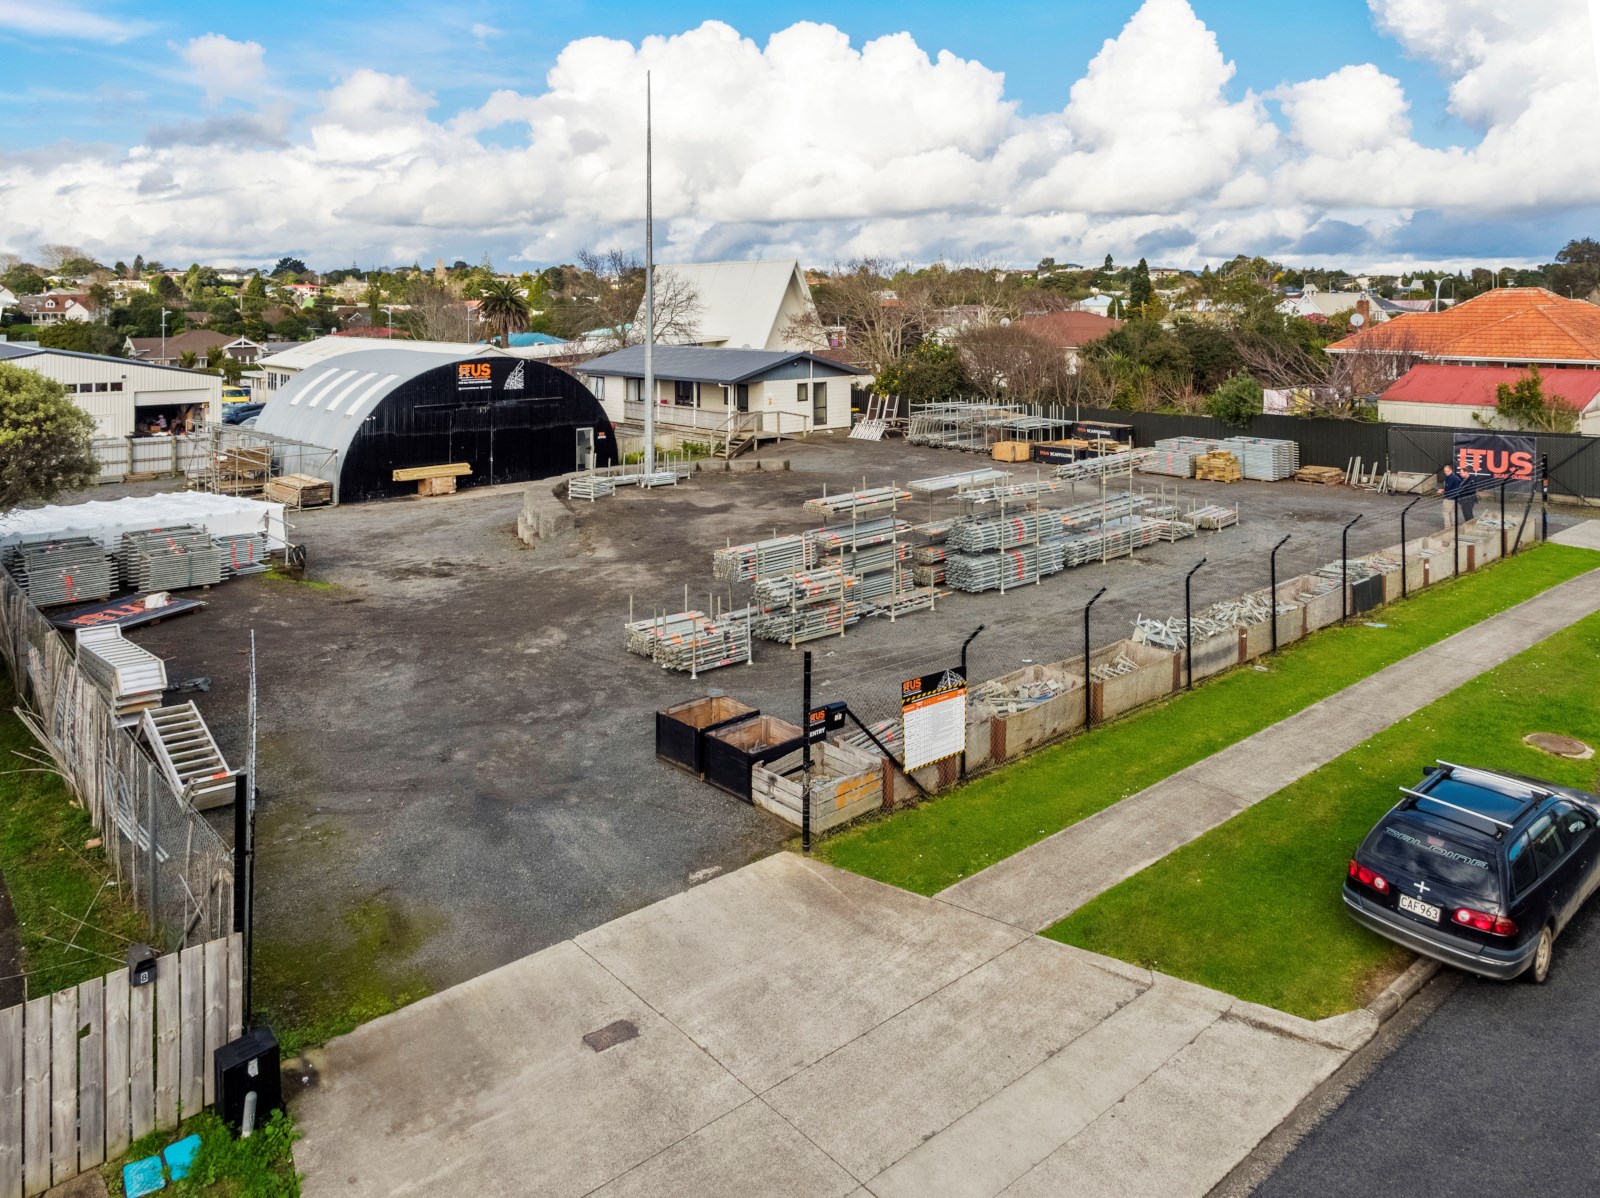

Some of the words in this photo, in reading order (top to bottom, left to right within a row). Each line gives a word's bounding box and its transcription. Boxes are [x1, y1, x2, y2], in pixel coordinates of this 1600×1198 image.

[459, 364, 491, 376] ITUS
[1459, 448, 1533, 476] ITUS
[1401, 896, 1438, 919] CAF963
